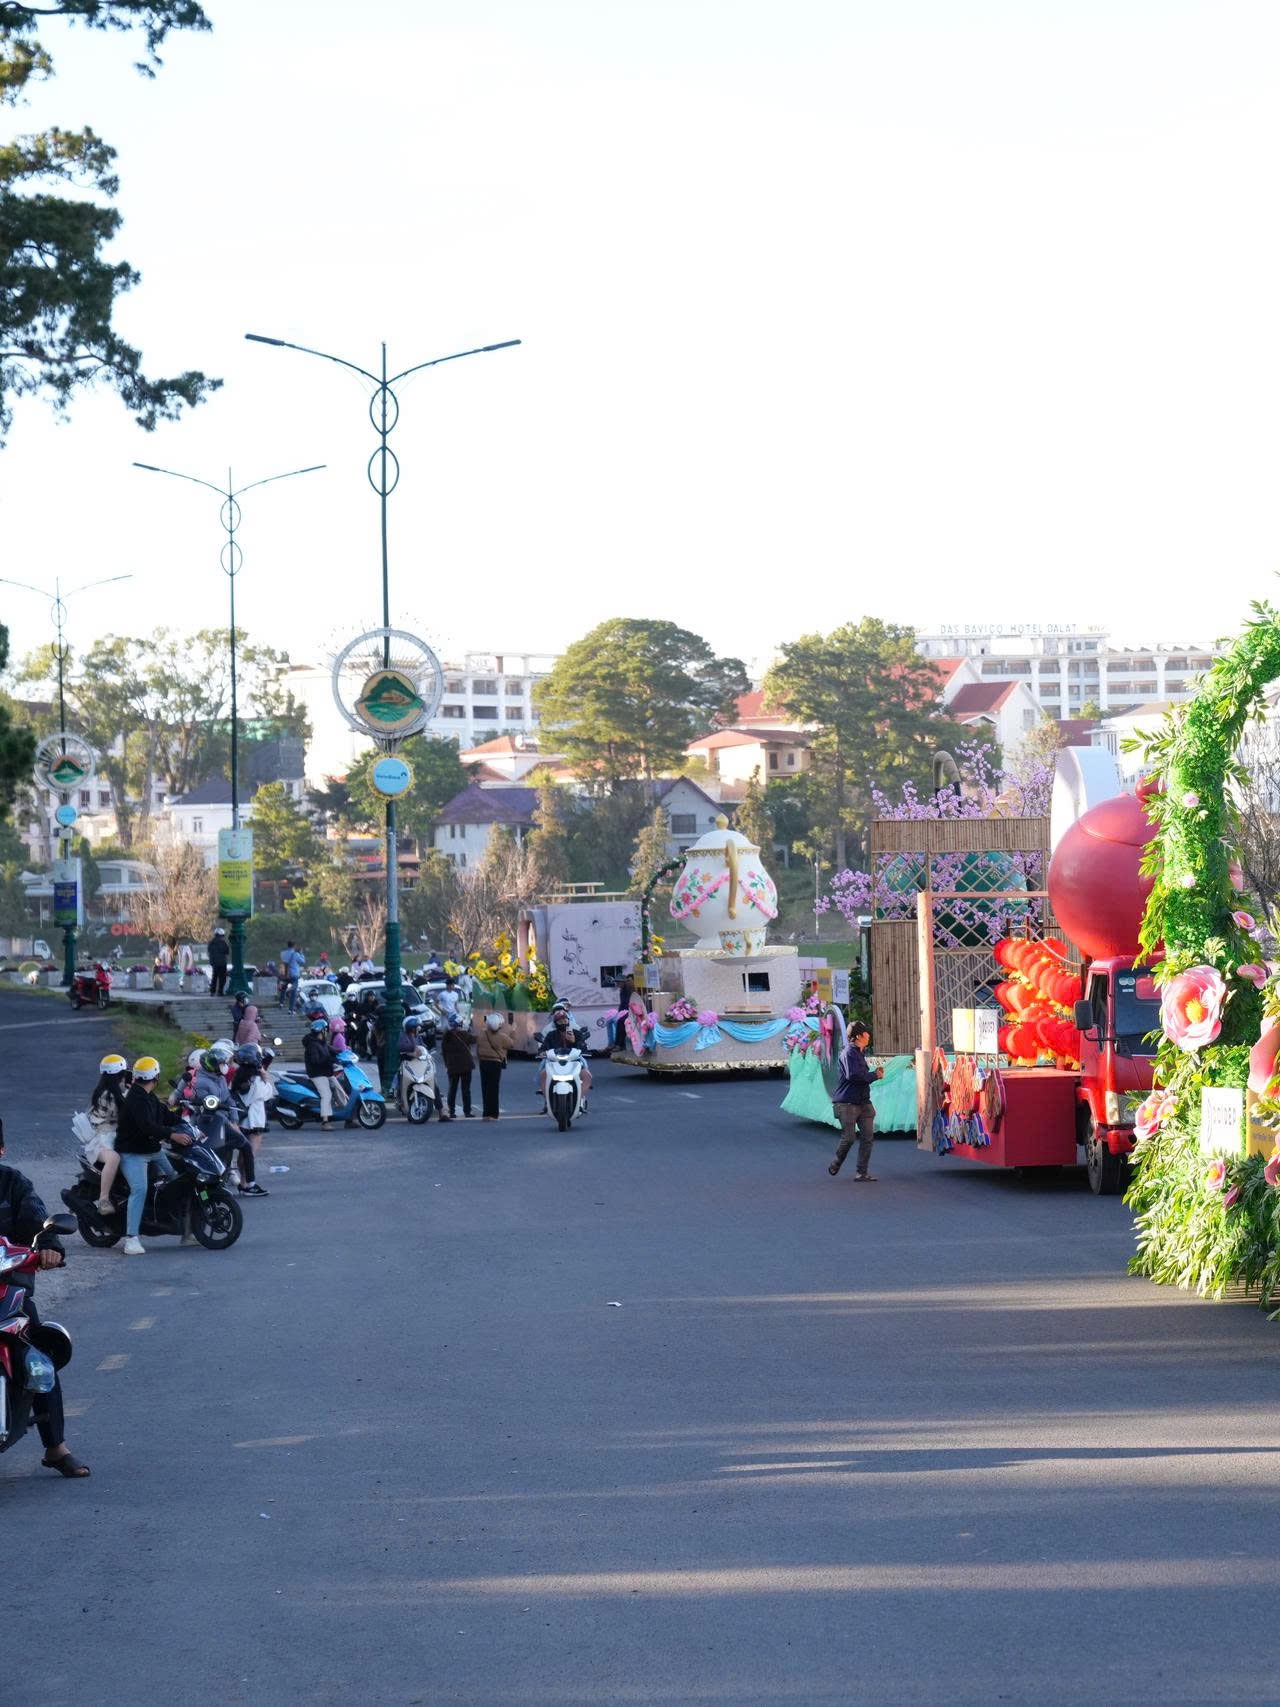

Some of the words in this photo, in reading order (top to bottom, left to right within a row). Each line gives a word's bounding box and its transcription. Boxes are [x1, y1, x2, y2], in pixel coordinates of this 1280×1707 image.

[940, 624, 959, 634] DAS
[1010, 624, 1043, 633] HOTEL
[1047, 624, 1077, 632] DALAT
